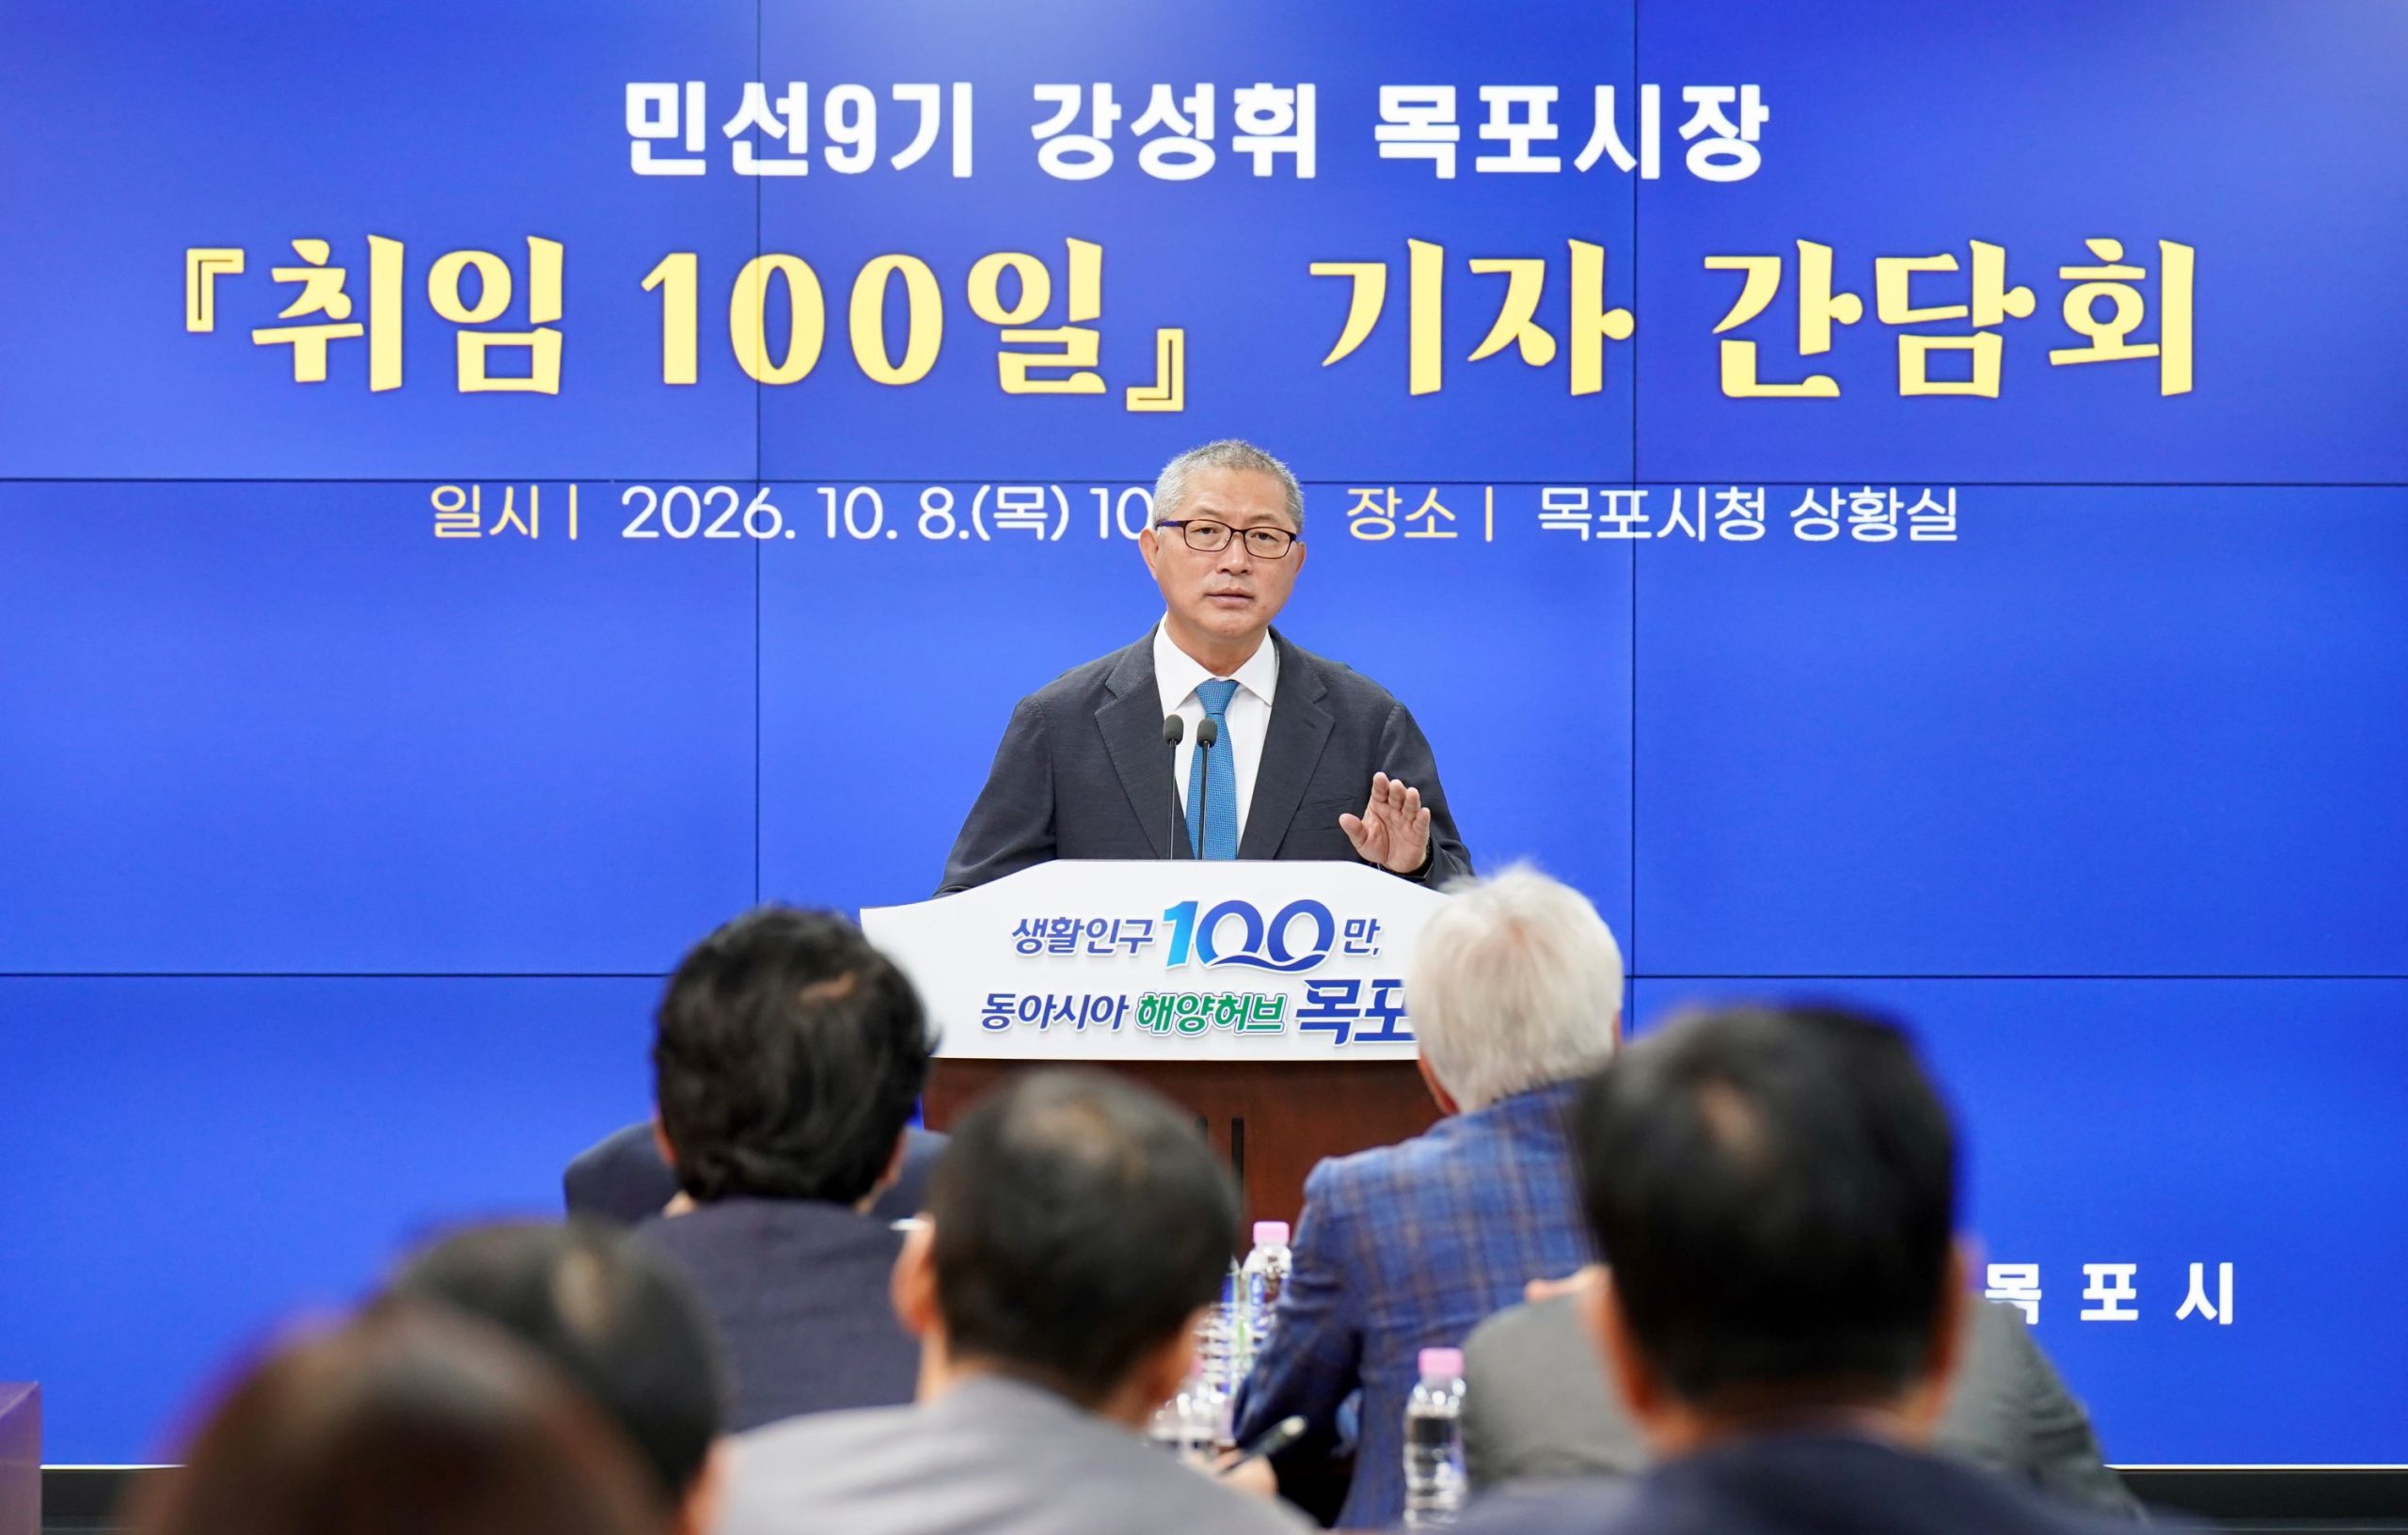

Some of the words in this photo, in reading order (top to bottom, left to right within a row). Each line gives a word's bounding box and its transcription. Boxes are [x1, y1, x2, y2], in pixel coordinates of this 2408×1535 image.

[626, 81, 973, 179] 민선9기
[1030, 82, 1316, 181] 강성휘
[1374, 84, 1769, 182] 목포시장
[186, 234, 563, 395] 『취임
[641, 237, 1184, 412] 100일』
[1309, 238, 1635, 396] 기자
[1704, 238, 2194, 399] 간담회
[431, 484, 539, 539] 일시
[622, 485, 796, 540] 2026.
[816, 486, 897, 540] 10.
[917, 484, 1069, 542] 8.(목)
[1346, 486, 1458, 541] 장소
[1538, 486, 1766, 542] 목포시청
[1790, 485, 1957, 543] 상황실
[1013, 918, 1152, 955] 생활인구
[981, 993, 1129, 1030] 동아시아
[1137, 993, 1285, 1033] 해양허브
[1296, 979, 1417, 1045] 목포
